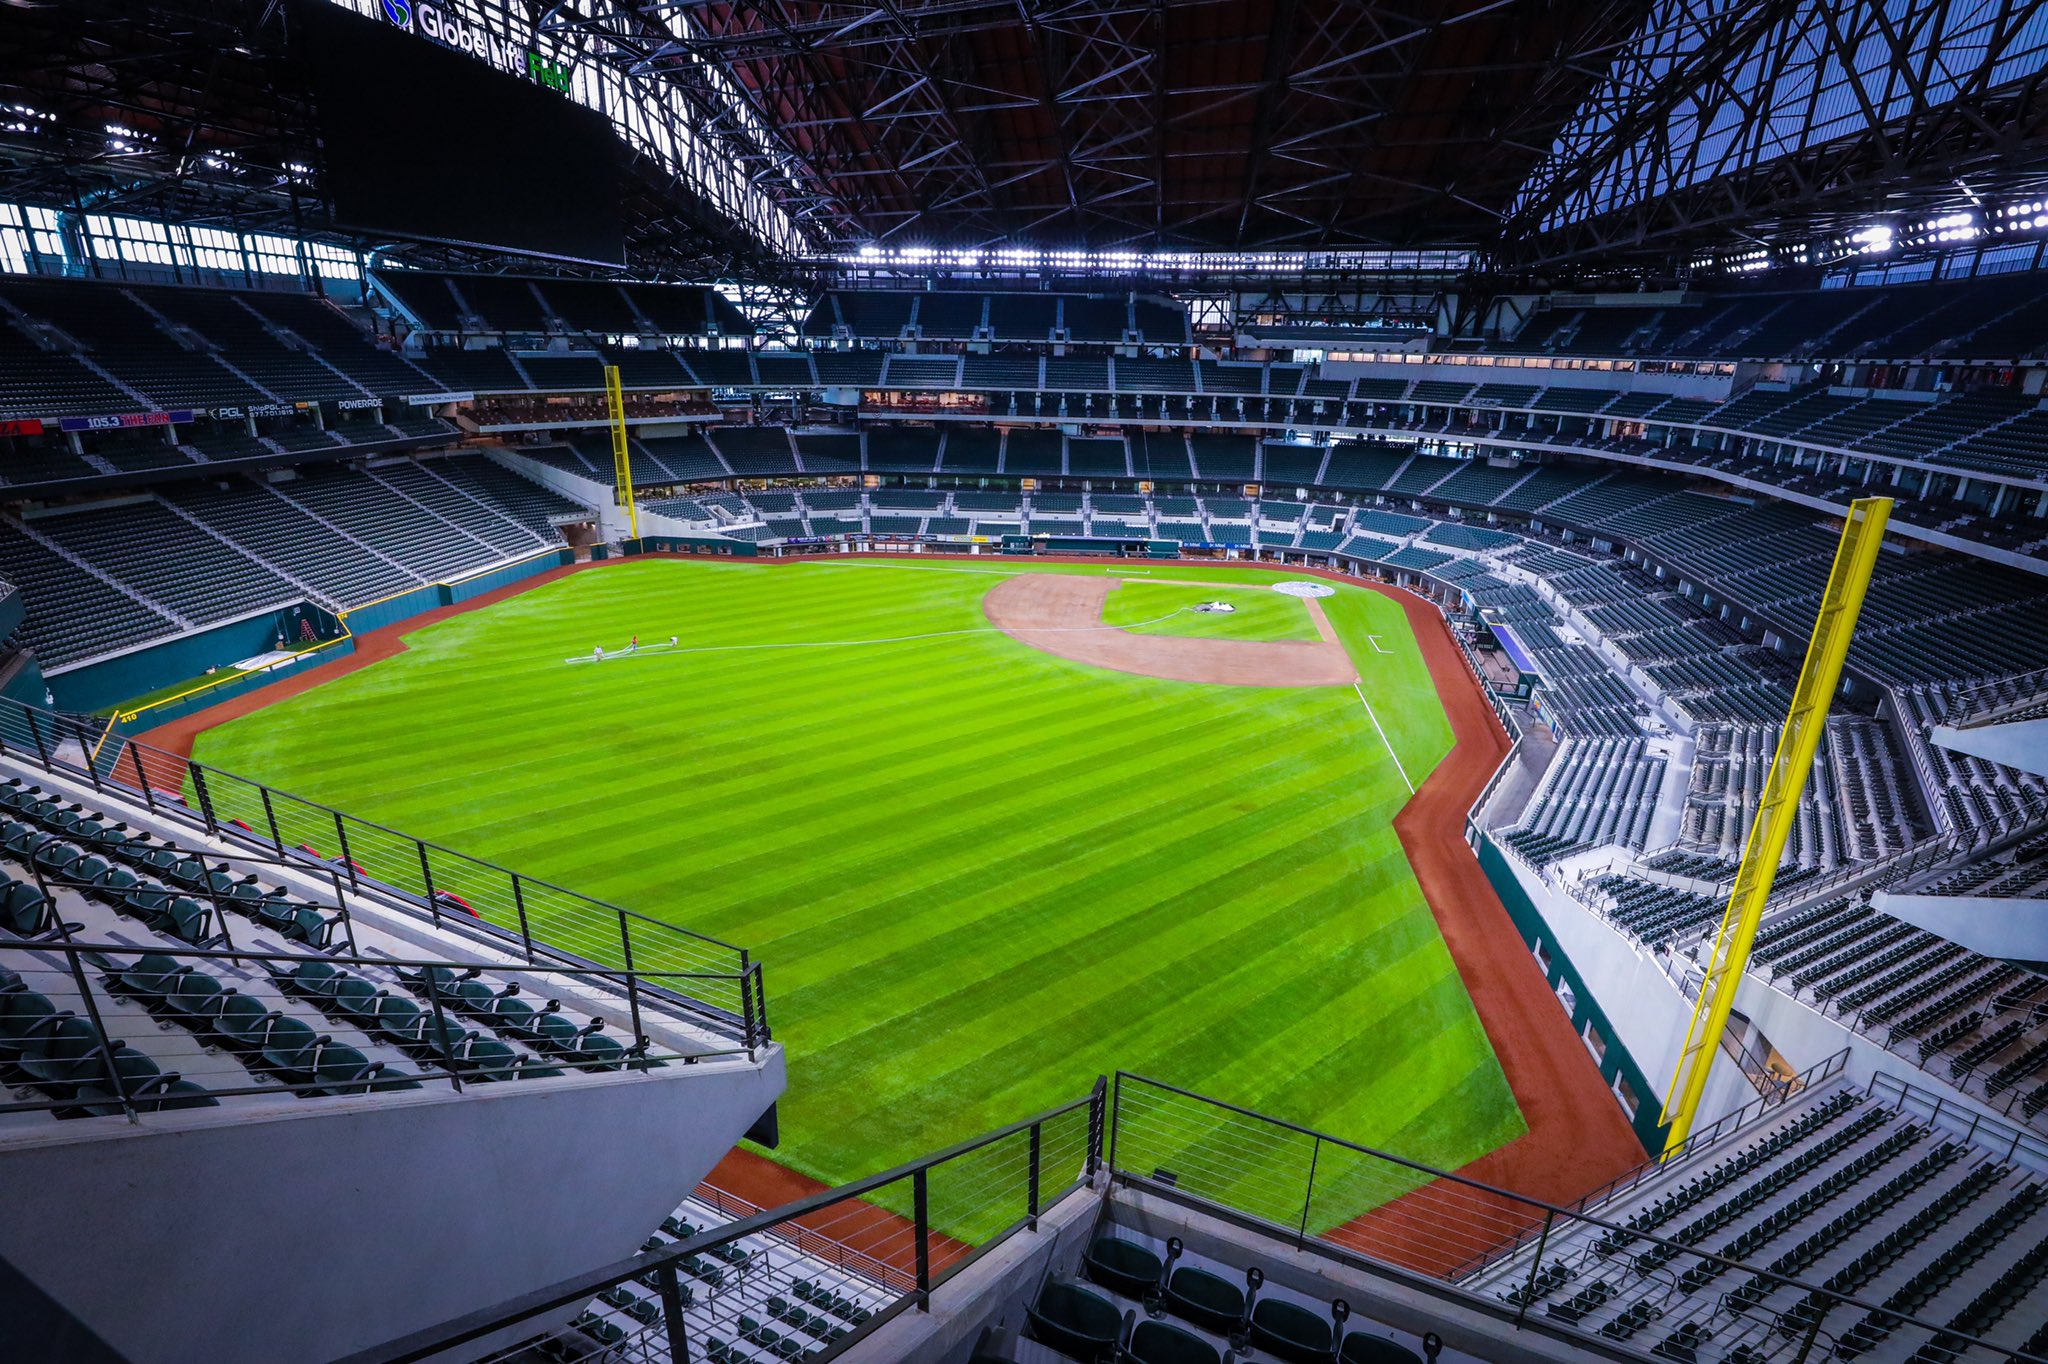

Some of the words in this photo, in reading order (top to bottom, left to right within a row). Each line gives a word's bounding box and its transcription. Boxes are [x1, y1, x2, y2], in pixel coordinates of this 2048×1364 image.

[418, 4, 487, 58] Globe
[489, 33, 527, 75] Life
[528, 52, 570, 93] Field
[338, 398, 384, 410] POWERADE
[219, 407, 244, 418] PGL
[87, 416, 120, 429] 105.3
[121, 414, 145, 427] THE
[146, 412, 170, 425] FAN
[121, 713, 137, 723] 410
